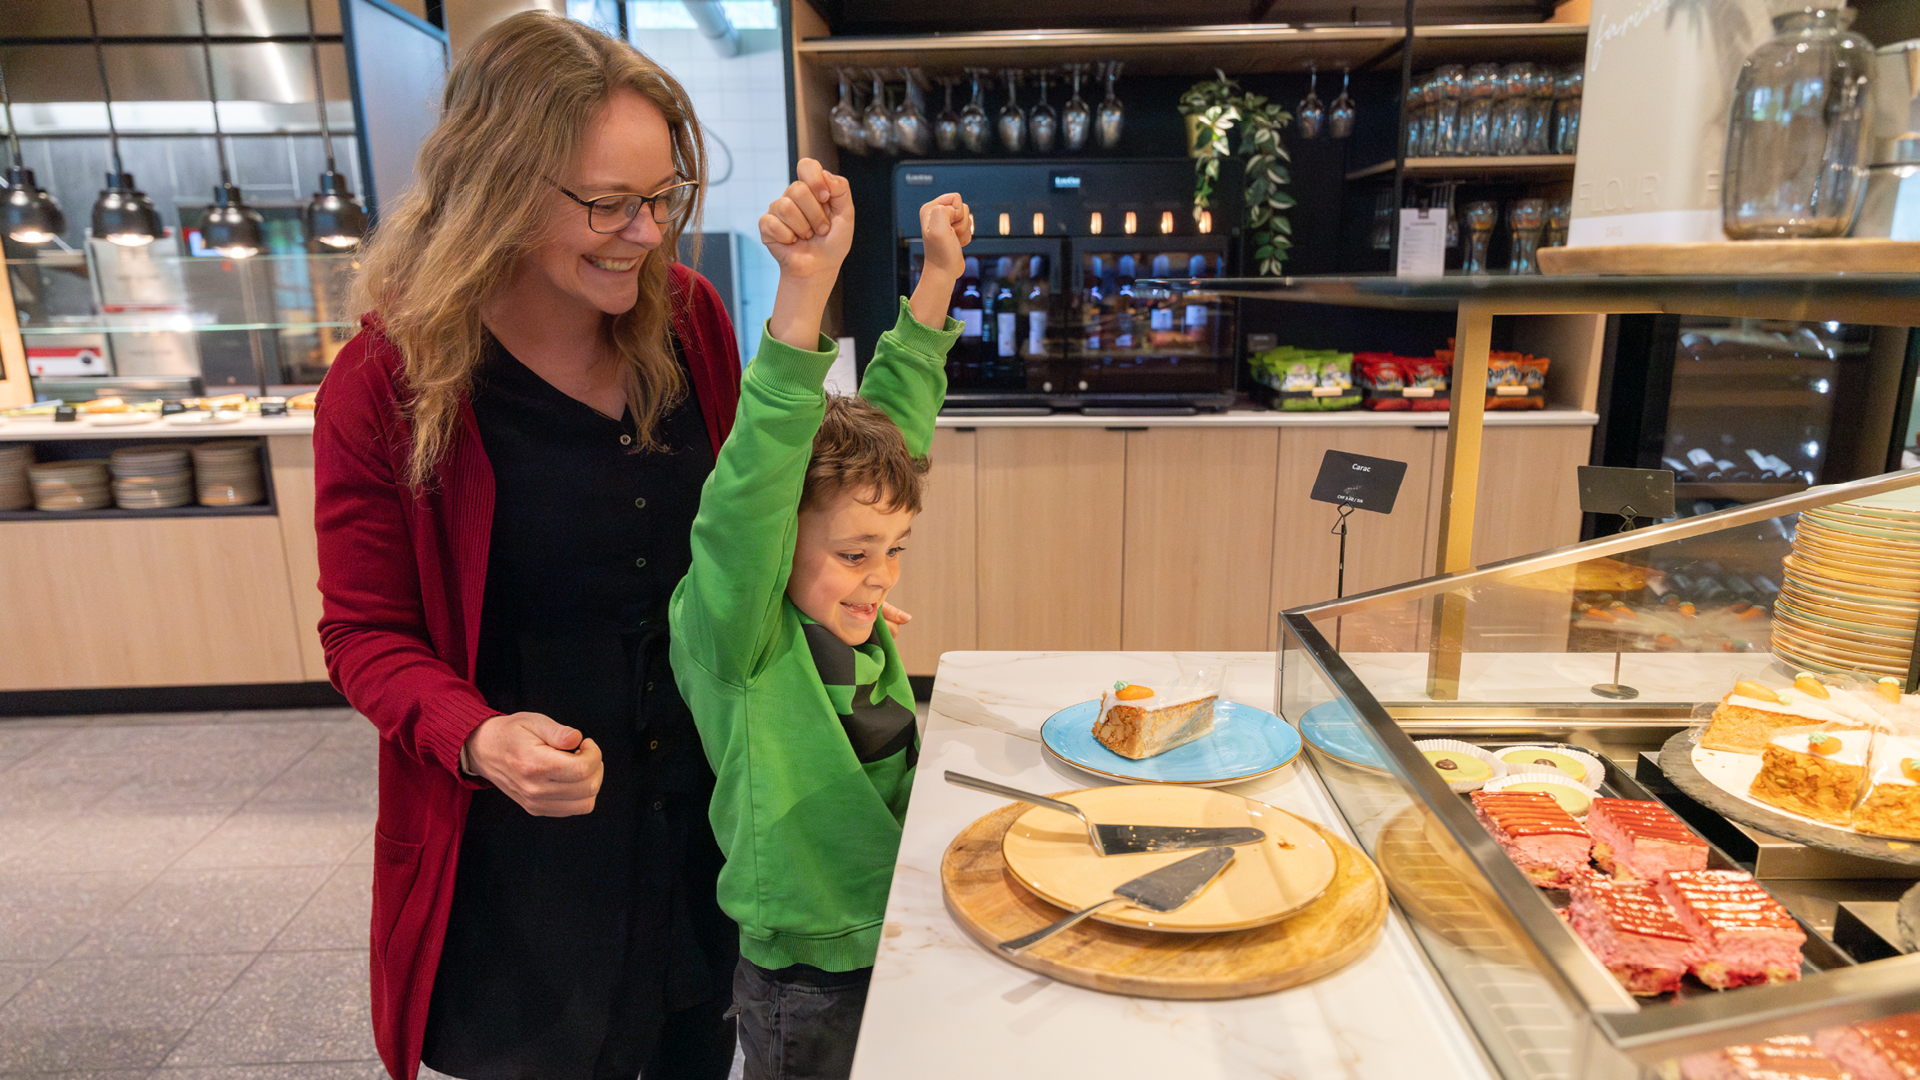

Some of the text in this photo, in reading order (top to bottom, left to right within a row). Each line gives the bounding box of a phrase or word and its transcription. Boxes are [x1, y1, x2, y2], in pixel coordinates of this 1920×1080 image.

[1591, 0, 1668, 72] farin
[1578, 172, 1660, 212] FLOUR
[1352, 463, 1371, 473] Carac
